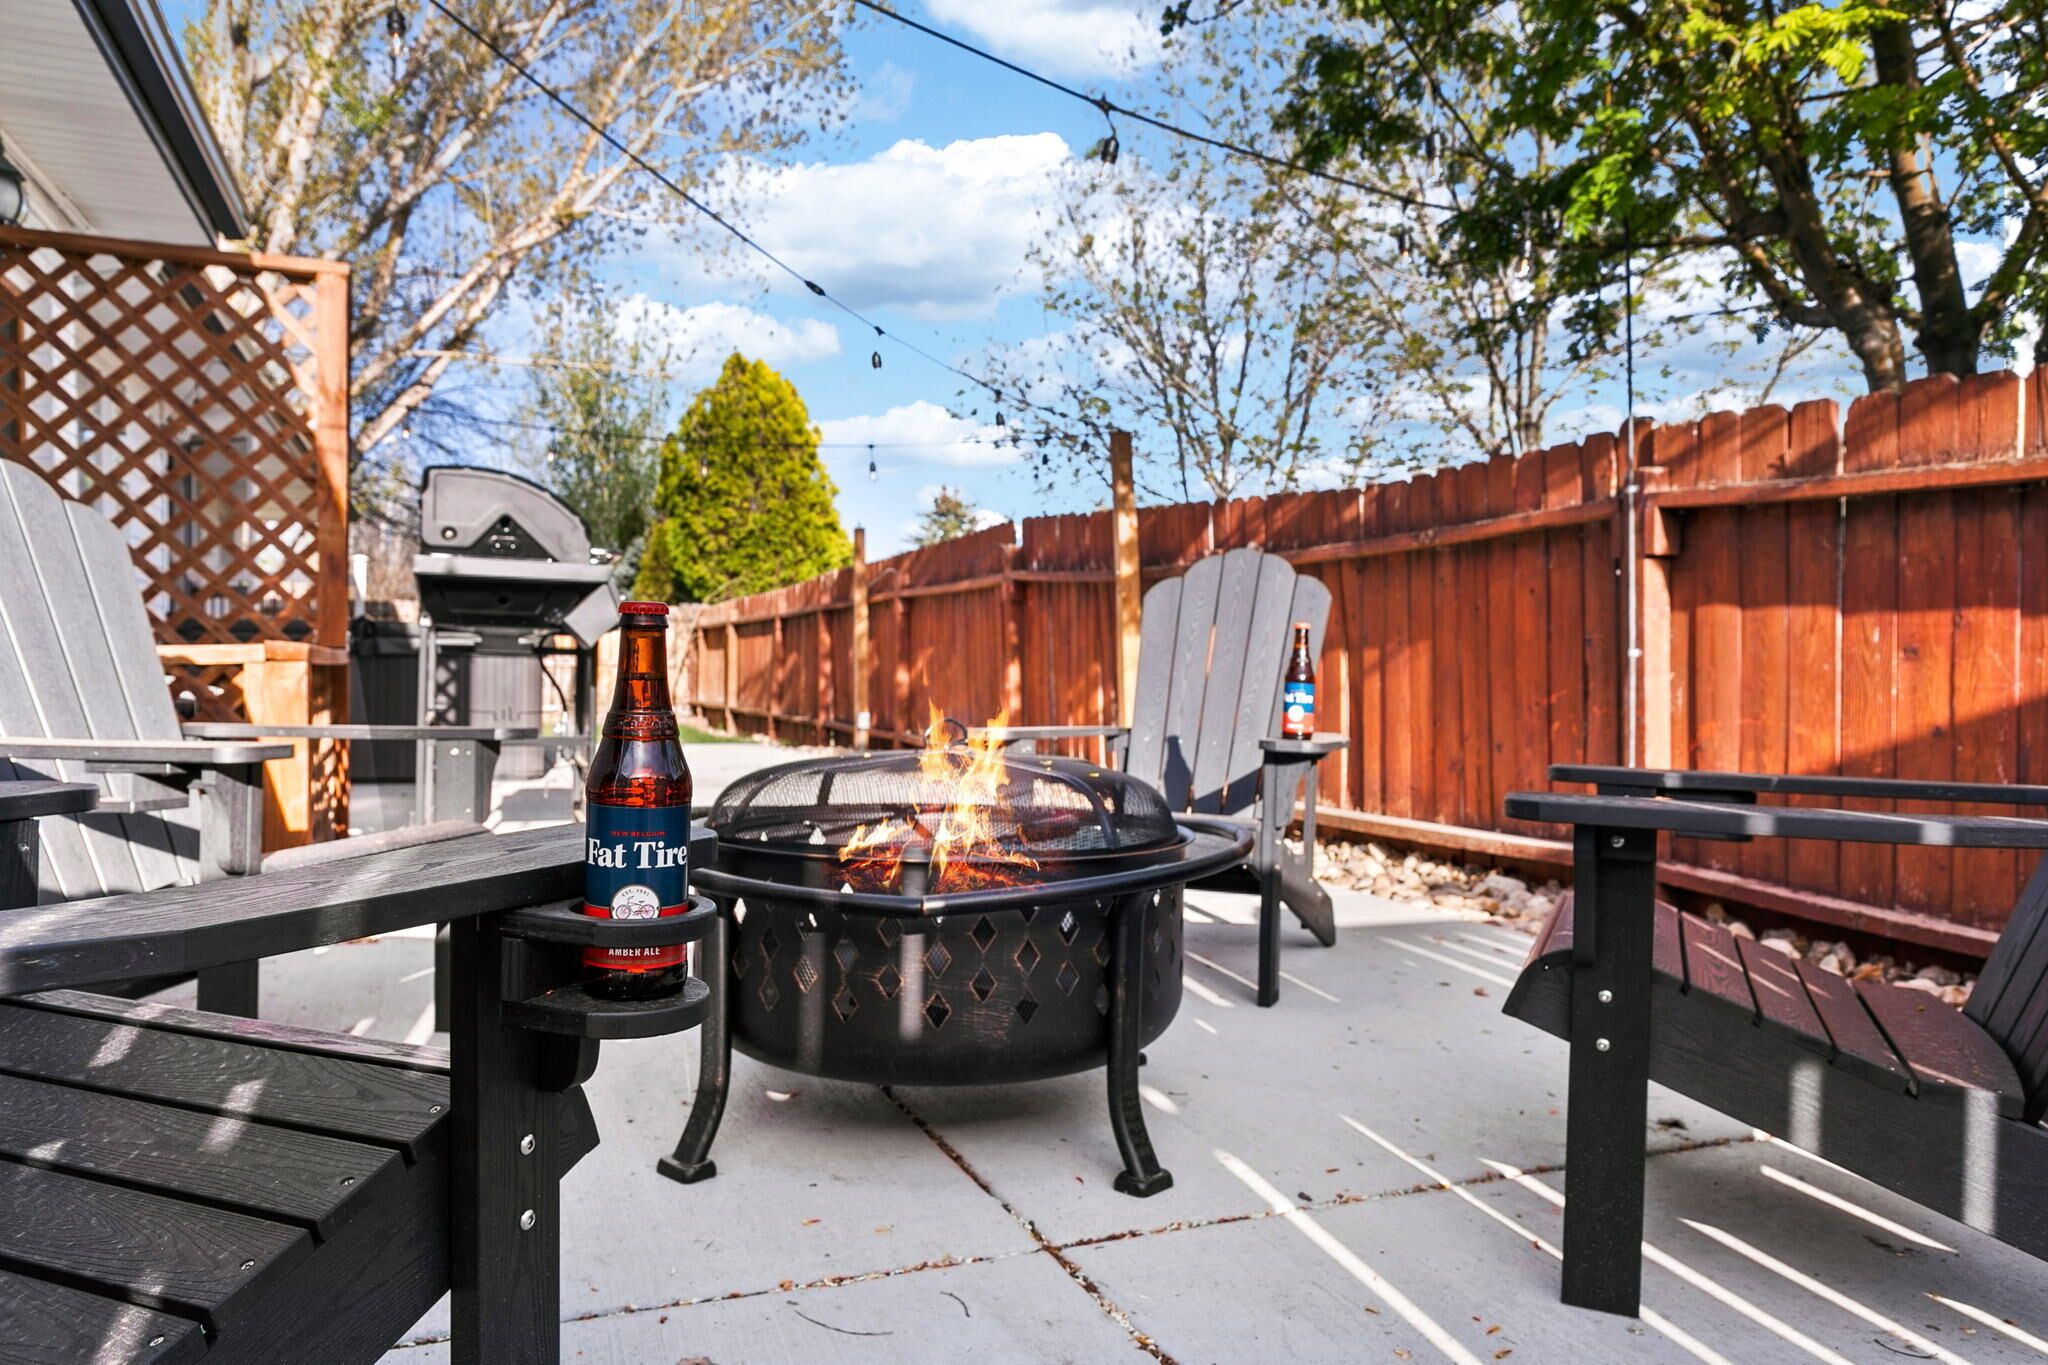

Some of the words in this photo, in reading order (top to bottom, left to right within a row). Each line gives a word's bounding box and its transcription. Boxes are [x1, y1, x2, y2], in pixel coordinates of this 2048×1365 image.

[588, 837, 627, 869] Fat
[633, 841, 687, 869] Tire
[608, 948, 641, 957] AMBER
[643, 947, 660, 956] ALE
